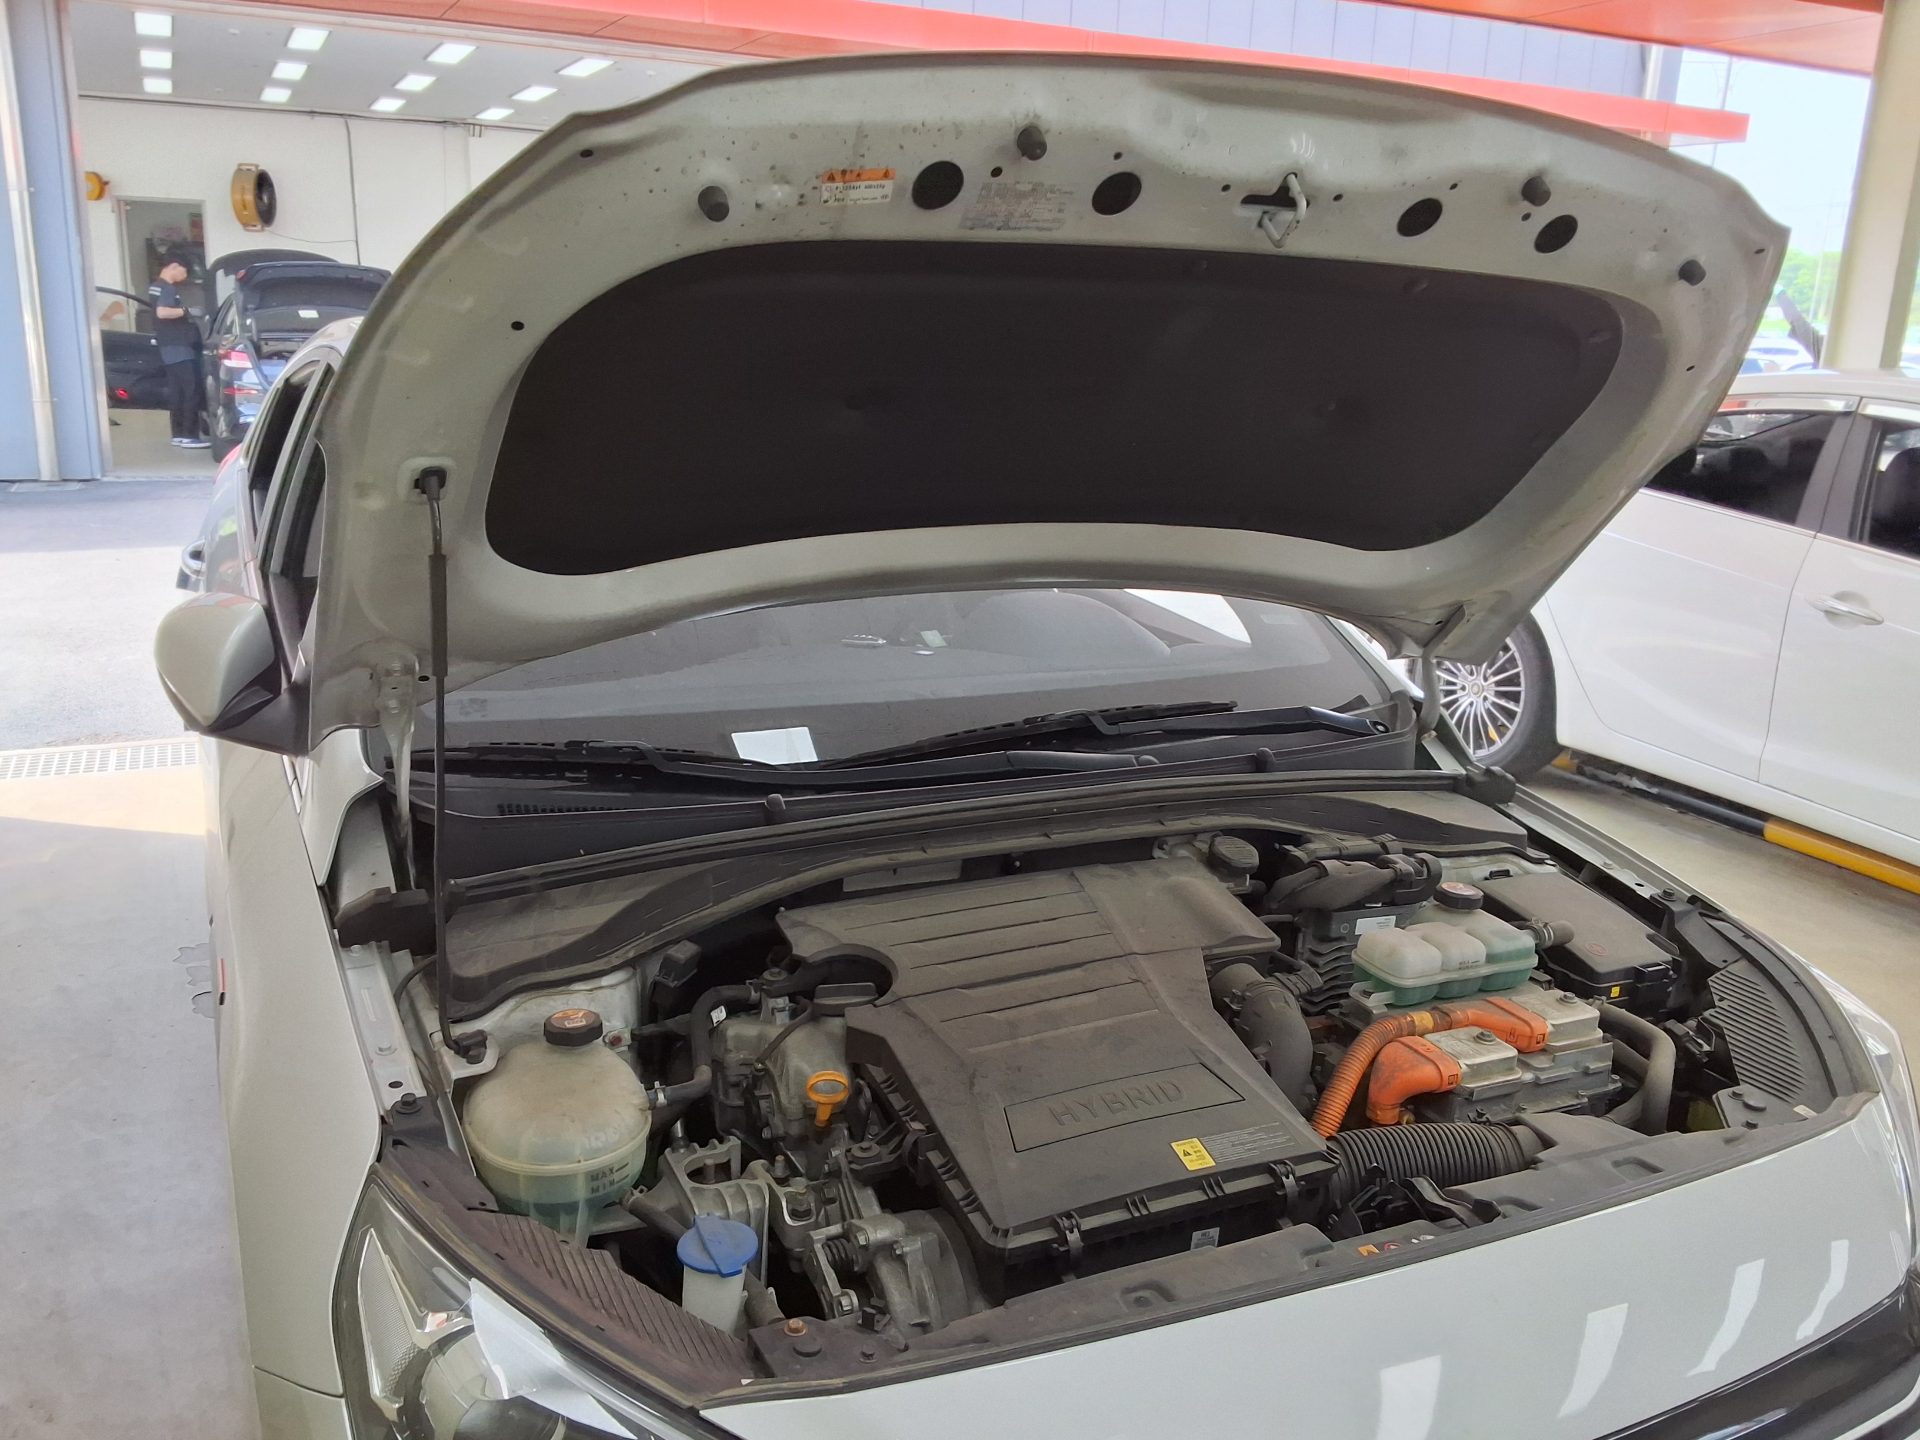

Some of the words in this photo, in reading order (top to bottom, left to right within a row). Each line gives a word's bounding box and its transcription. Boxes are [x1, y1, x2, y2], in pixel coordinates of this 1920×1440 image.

[1048, 1081, 1183, 1126] HYBRID
[591, 1167, 615, 1182] MAX
[591, 1178, 615, 1194] MIN
